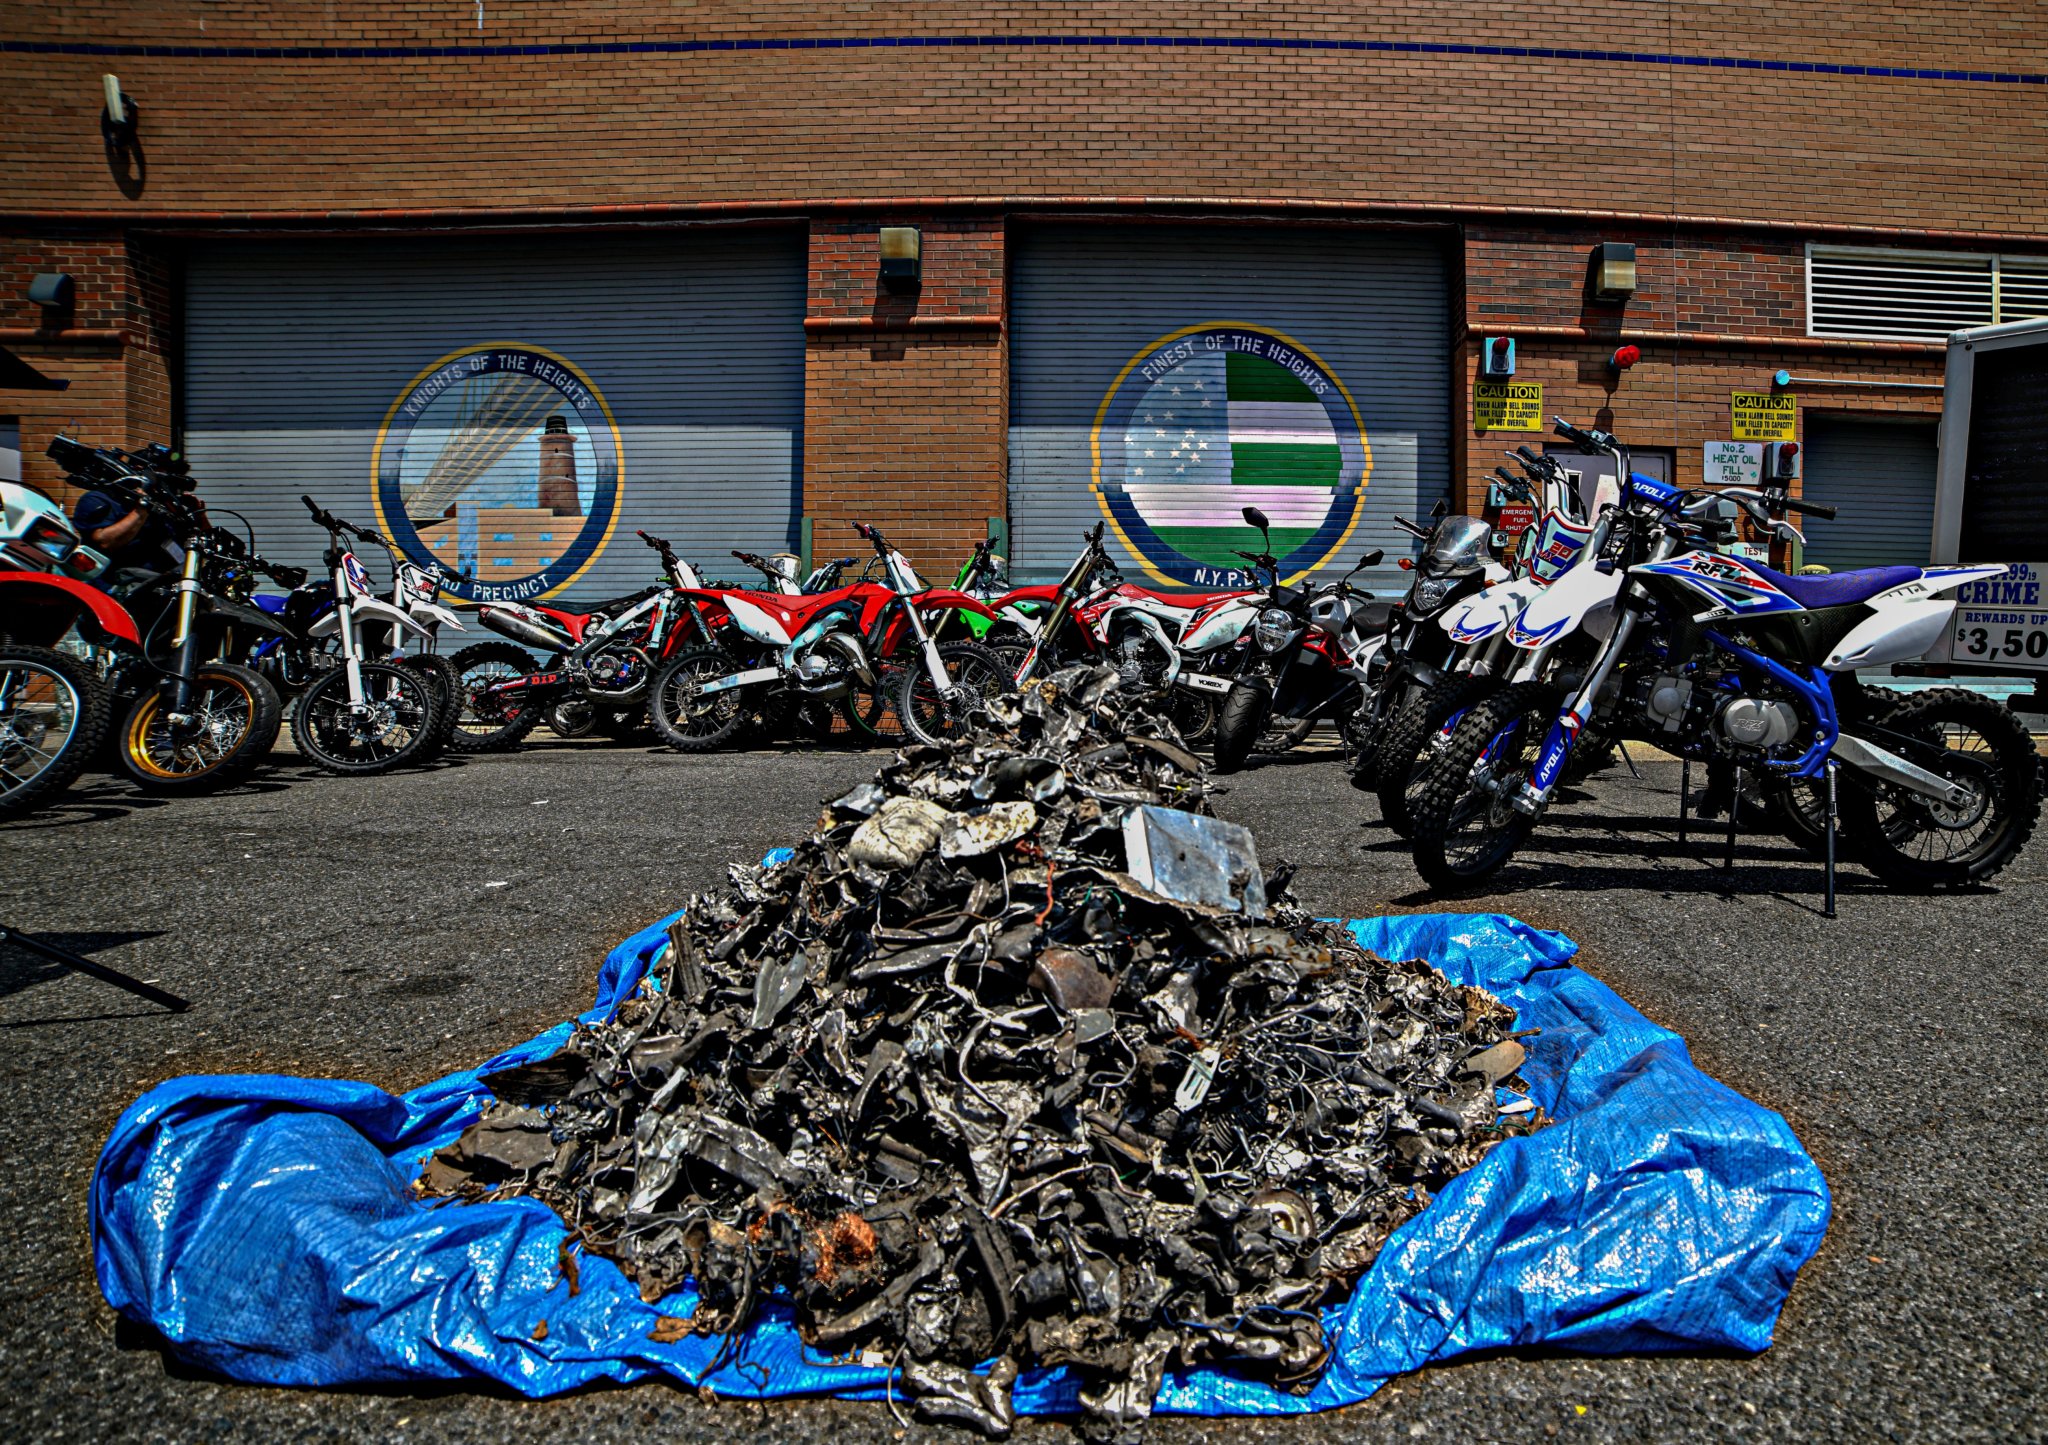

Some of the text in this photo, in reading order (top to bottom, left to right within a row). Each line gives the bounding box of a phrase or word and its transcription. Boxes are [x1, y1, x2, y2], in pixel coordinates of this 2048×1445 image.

[1141, 334, 1329, 394] FINEST OF THE HEIGHTS
[404, 354, 591, 417] KNIGHTS OF THE HEIGHTS
[1478, 385, 1538, 398] CAUTION
[1509, 402, 1520, 410] BELL
[1521, 402, 1539, 410] SOUNDS
[1736, 396, 1792, 409] CAUTION
[1516, 411, 1538, 419] CAPACITY
[1507, 419, 1528, 427] OVERFILL
[1748, 420, 1762, 428] FILLED
[1772, 421, 1792, 429] CAPACITY
[1722, 443, 1745, 453] No.2
[1713, 454, 1757, 464] HEAT OIL
[1723, 466, 1744, 475] FILL
[1744, 547, 1763, 555] TEST
[472, 574, 549, 601] PRECINCT
[744, 591, 778, 602] HONDA
[1957, 582, 2040, 605] CRIME
[1965, 612, 2048, 625] REWARDS UP
[1198, 678, 1223, 689] VORTEX
